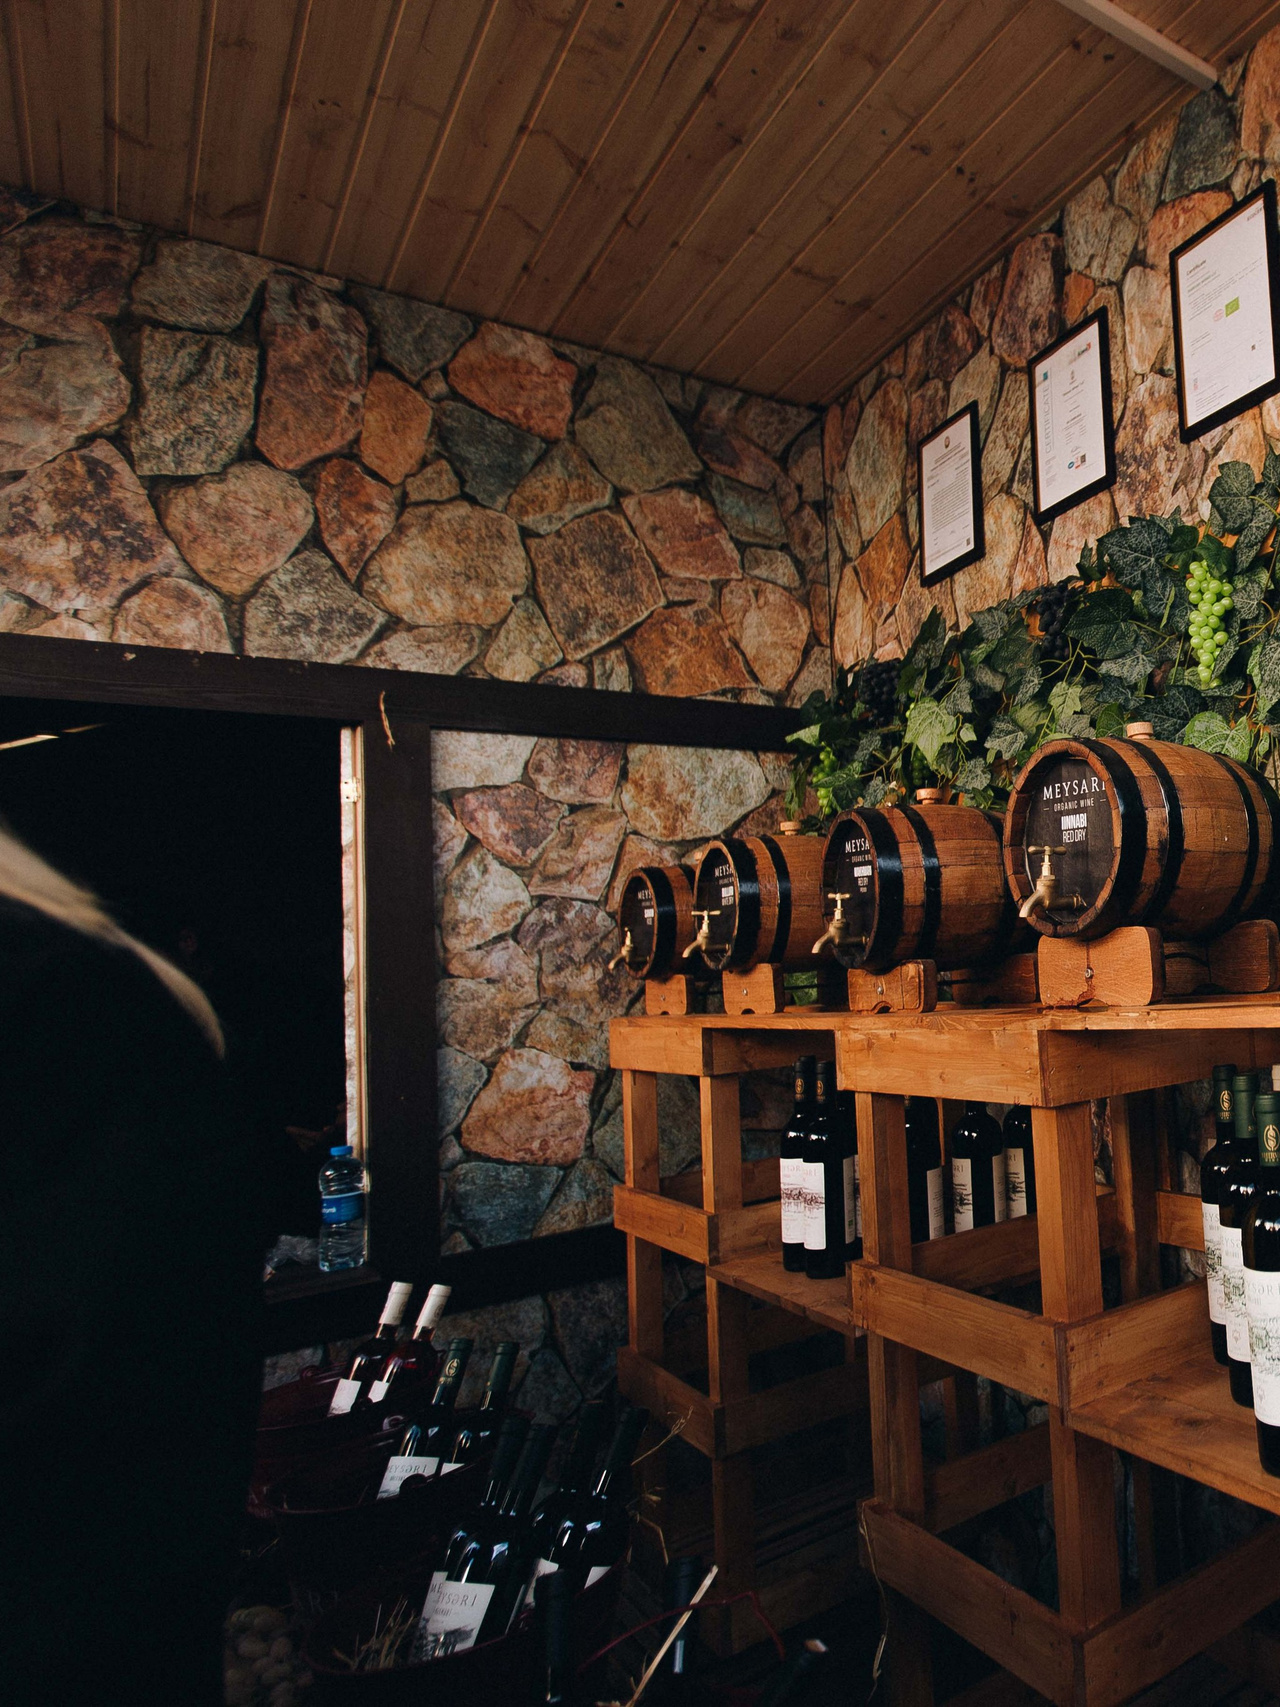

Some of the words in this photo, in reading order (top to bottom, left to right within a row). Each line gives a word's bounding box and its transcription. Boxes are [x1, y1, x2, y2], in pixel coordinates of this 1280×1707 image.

[1042, 386, 1052, 452] CERTIFICATE
[1043, 777, 1105, 800] MEYSARI
[1053, 800, 1078, 812] ORGANIC
[1080, 797, 1094, 808] WINE
[1062, 830, 1074, 843] RED
[1074, 829, 1086, 842] DRY
